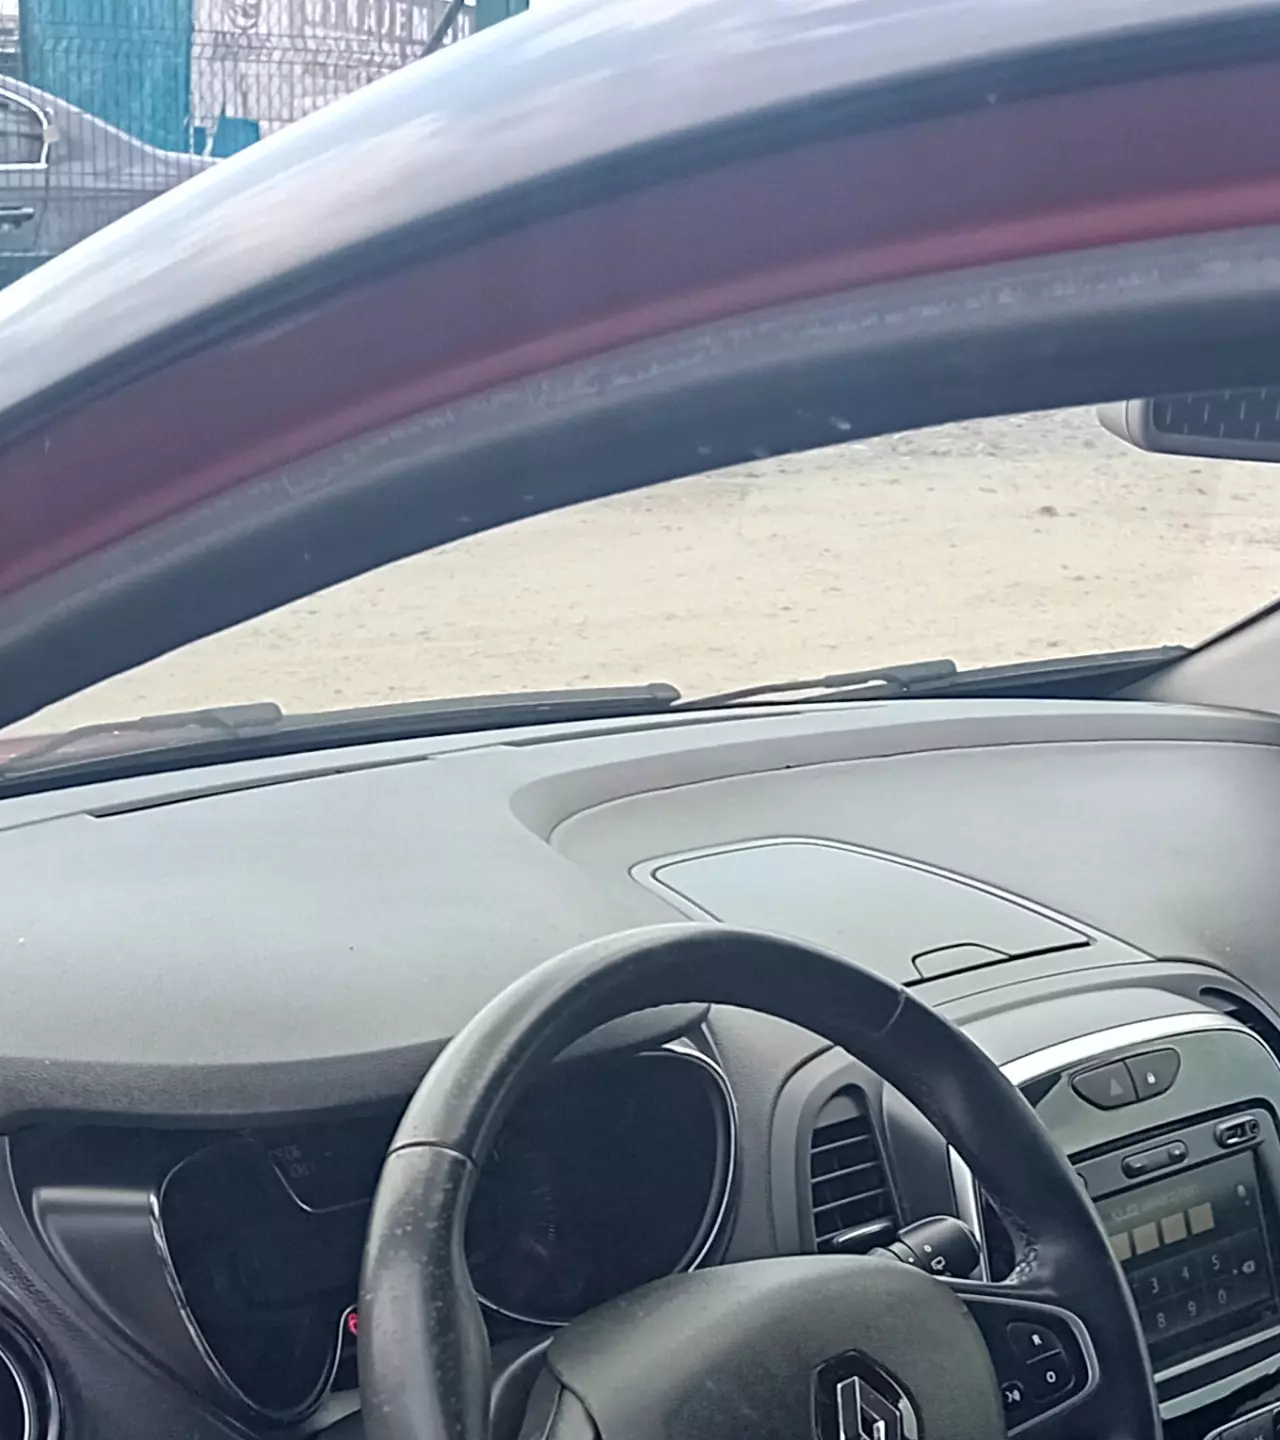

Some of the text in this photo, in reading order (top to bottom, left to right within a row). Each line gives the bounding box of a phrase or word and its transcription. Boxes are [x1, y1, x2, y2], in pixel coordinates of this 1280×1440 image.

[1150, 1277, 1160, 1294] 3
[1211, 1254, 1220, 1270] 5
[1156, 1312, 1166, 1328] 8
[1187, 1300, 1197, 1316] 9
[1031, 1333, 1043, 1346] R
